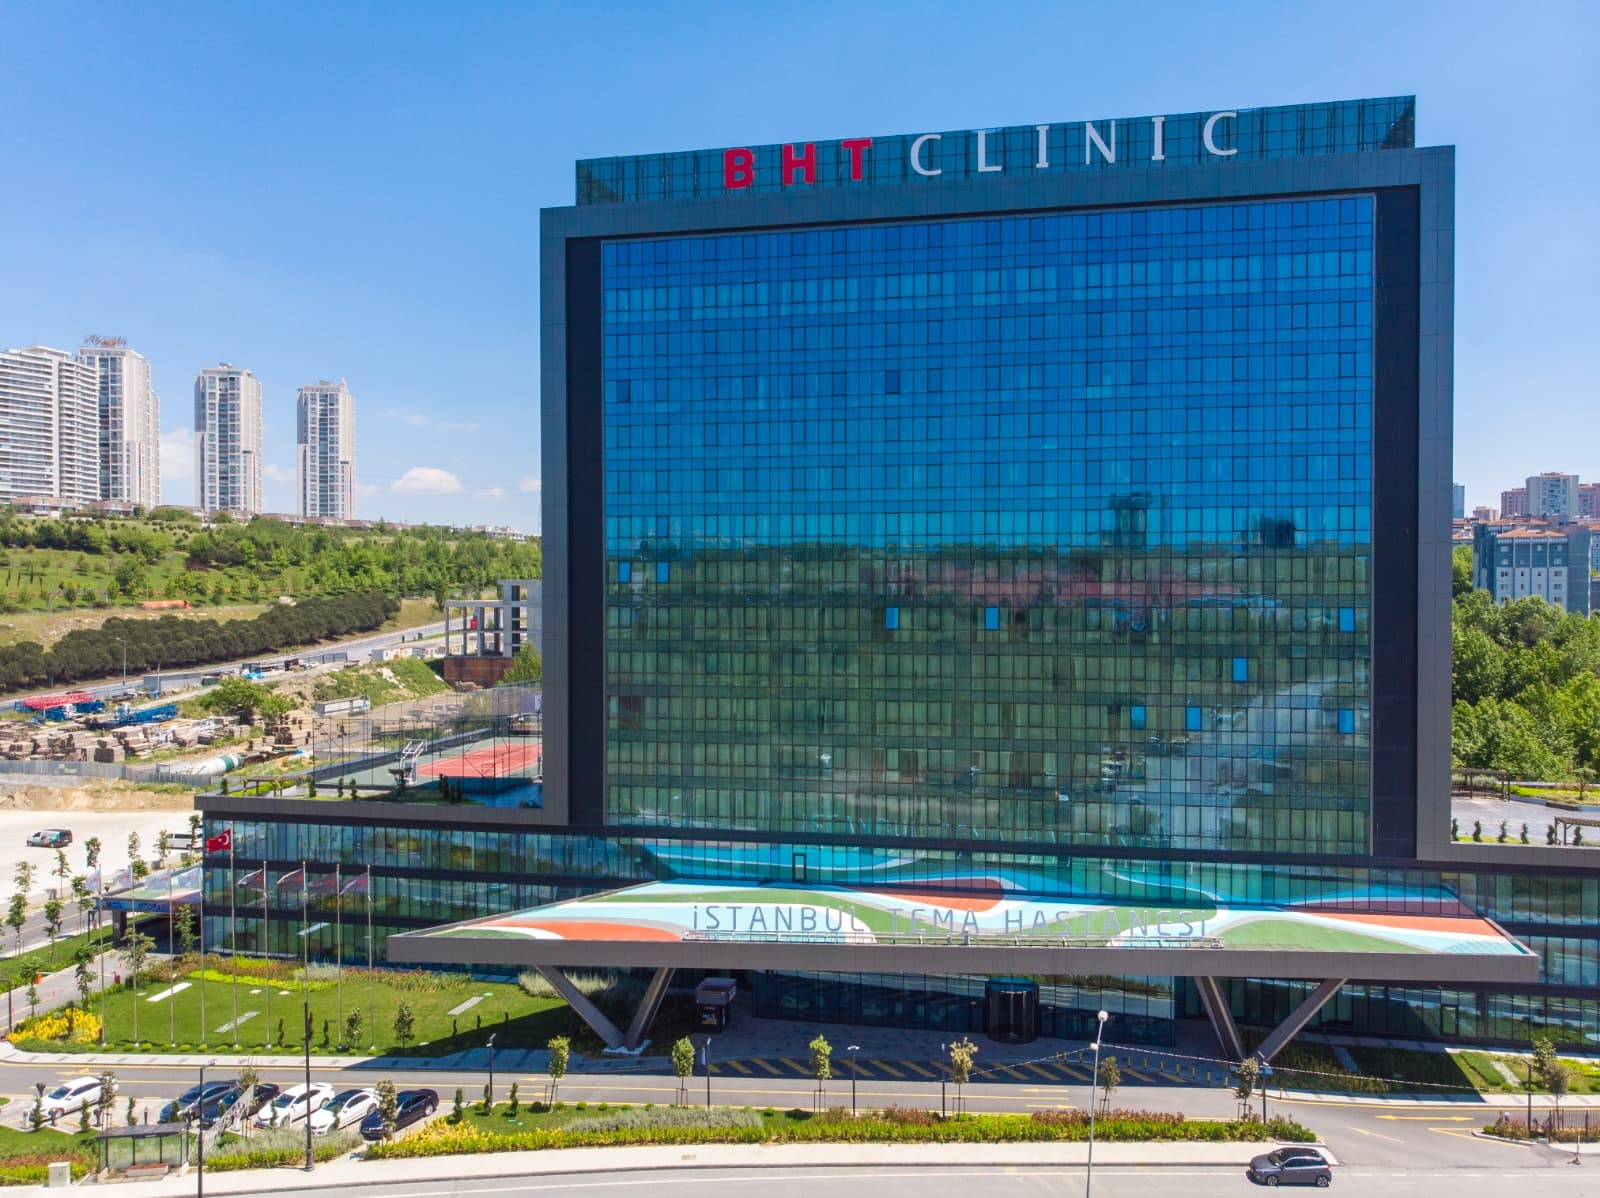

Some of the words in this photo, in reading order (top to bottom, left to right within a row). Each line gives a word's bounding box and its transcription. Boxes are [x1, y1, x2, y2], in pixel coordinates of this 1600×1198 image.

[723, 137, 872, 189] BHT
[910, 111, 1238, 177] CLINIC
[694, 905, 865, 932] İSTANBUL
[887, 908, 981, 936] TEMA
[1005, 910, 1206, 937] HASTANESİ
